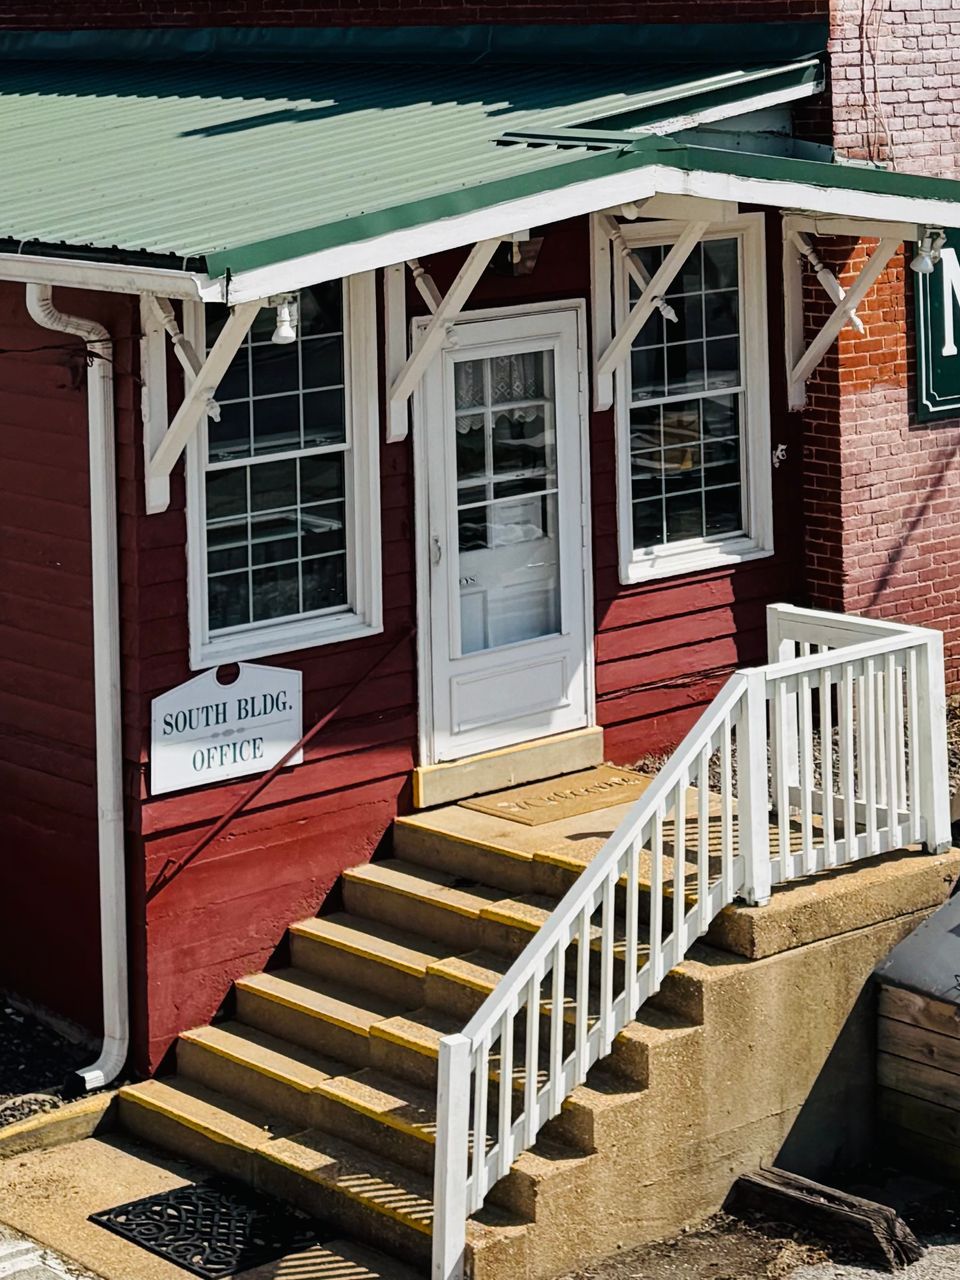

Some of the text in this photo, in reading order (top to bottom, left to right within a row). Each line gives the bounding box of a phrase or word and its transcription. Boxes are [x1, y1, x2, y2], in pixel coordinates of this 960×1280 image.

[162, 690, 293, 736] SOUTH BLDG.
[192, 737, 264, 772] OFFICE
